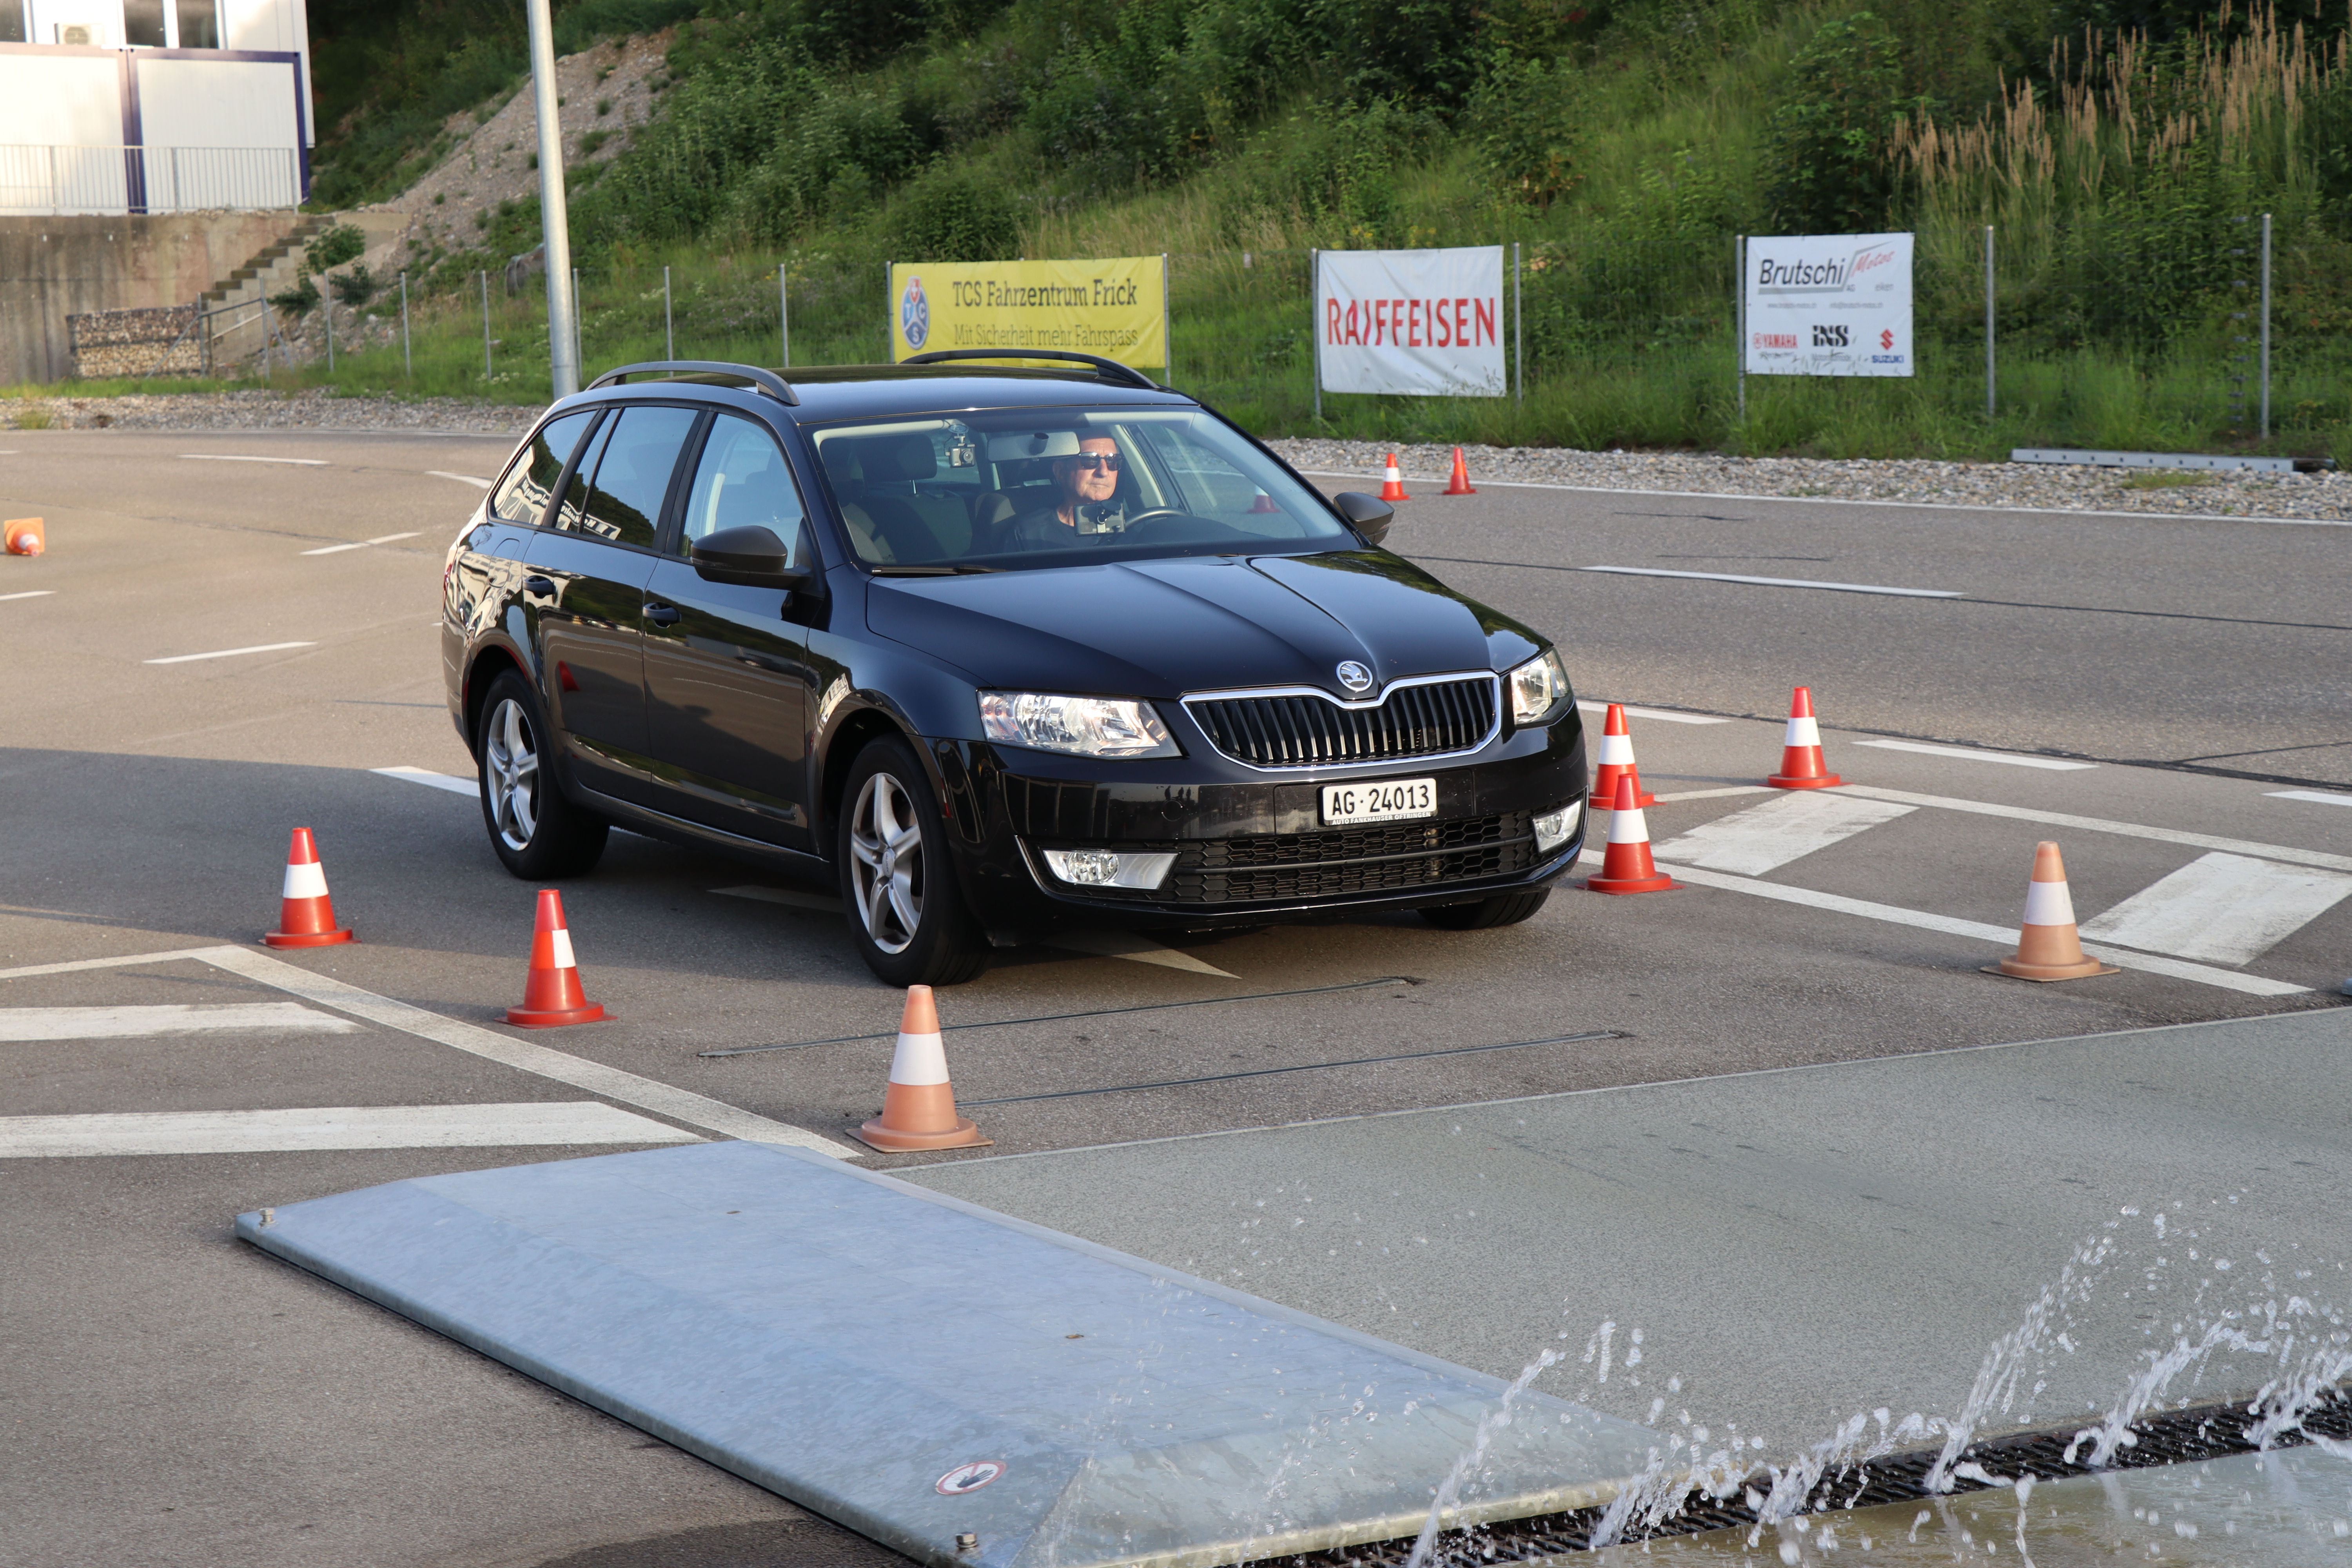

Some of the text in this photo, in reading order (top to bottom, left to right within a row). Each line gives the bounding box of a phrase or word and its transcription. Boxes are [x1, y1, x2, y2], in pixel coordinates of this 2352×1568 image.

[1759, 258, 1845, 285] Brutschi
[953, 278, 1137, 307] TCS Fahrzentrum Frick
[1327, 297, 1496, 348] RAIFFEISEN
[955, 324, 1138, 352] Mit Sicherheit mehr Fahrspass
[1763, 334, 1798, 349] YAMAHA
[1871, 354, 1904, 364] SUZUKI
[1350, 815, 1393, 824] FANKHAUSER
[1395, 811, 1432, 820] OFTRINGEN
